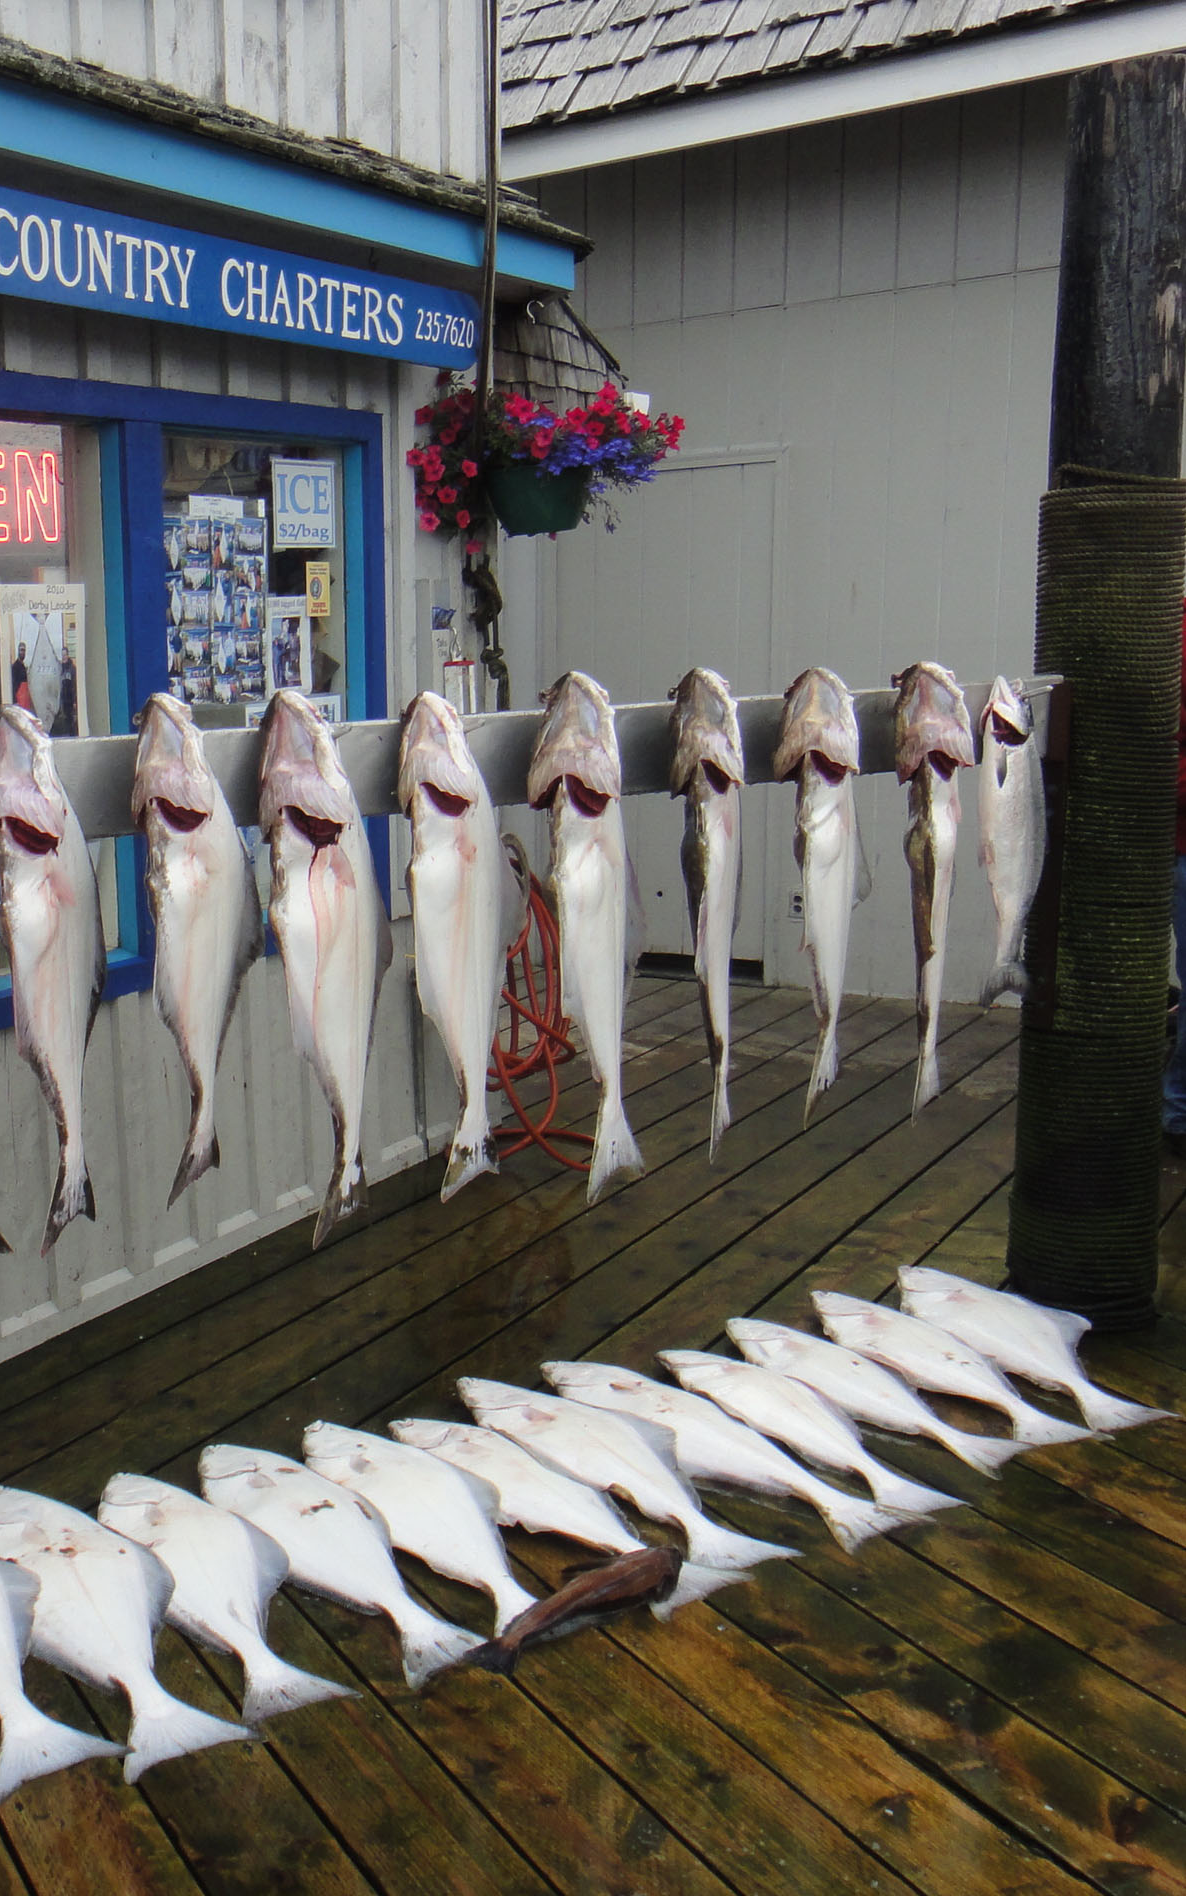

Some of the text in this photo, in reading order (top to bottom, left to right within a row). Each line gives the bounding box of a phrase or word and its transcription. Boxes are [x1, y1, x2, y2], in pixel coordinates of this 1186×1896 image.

[220, 258, 403, 346] CHARTERS
[276, 473, 330, 514] ICE
[279, 523, 329, 541] $2/bag
[46, 585, 65, 594] 2010
[29, 600, 49, 612] Derby
[50, 600, 77, 610] Leader
